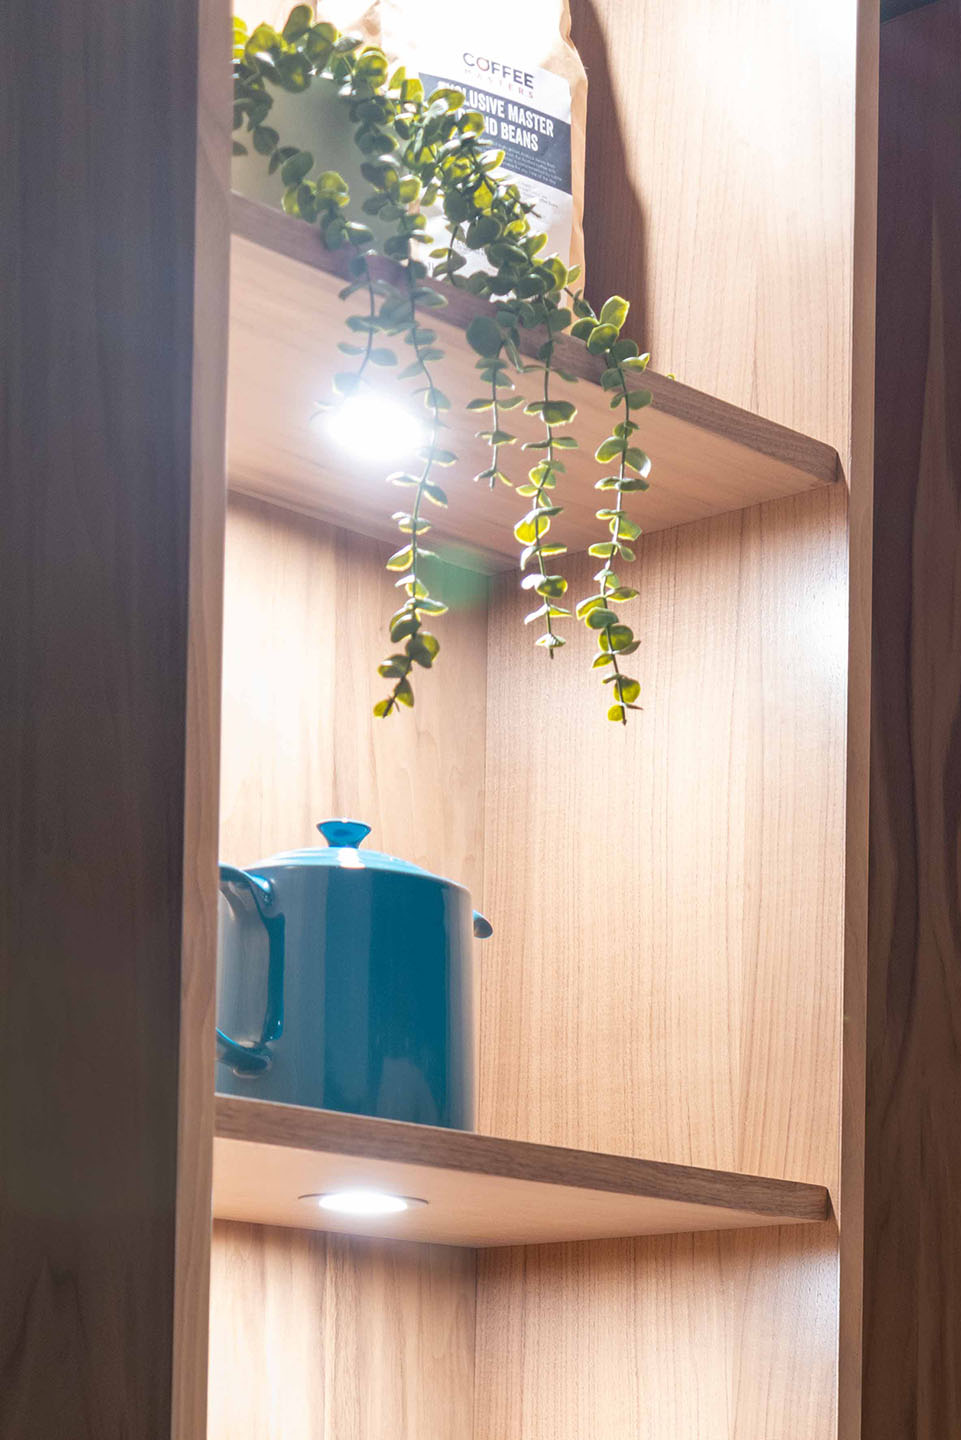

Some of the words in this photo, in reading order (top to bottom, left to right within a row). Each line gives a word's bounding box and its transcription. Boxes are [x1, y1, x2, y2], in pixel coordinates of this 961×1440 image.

[463, 52, 535, 90] COFFEE
[457, 107, 499, 137] BND
[500, 121, 539, 152] BEANS
[507, 102, 554, 138] MASTER
